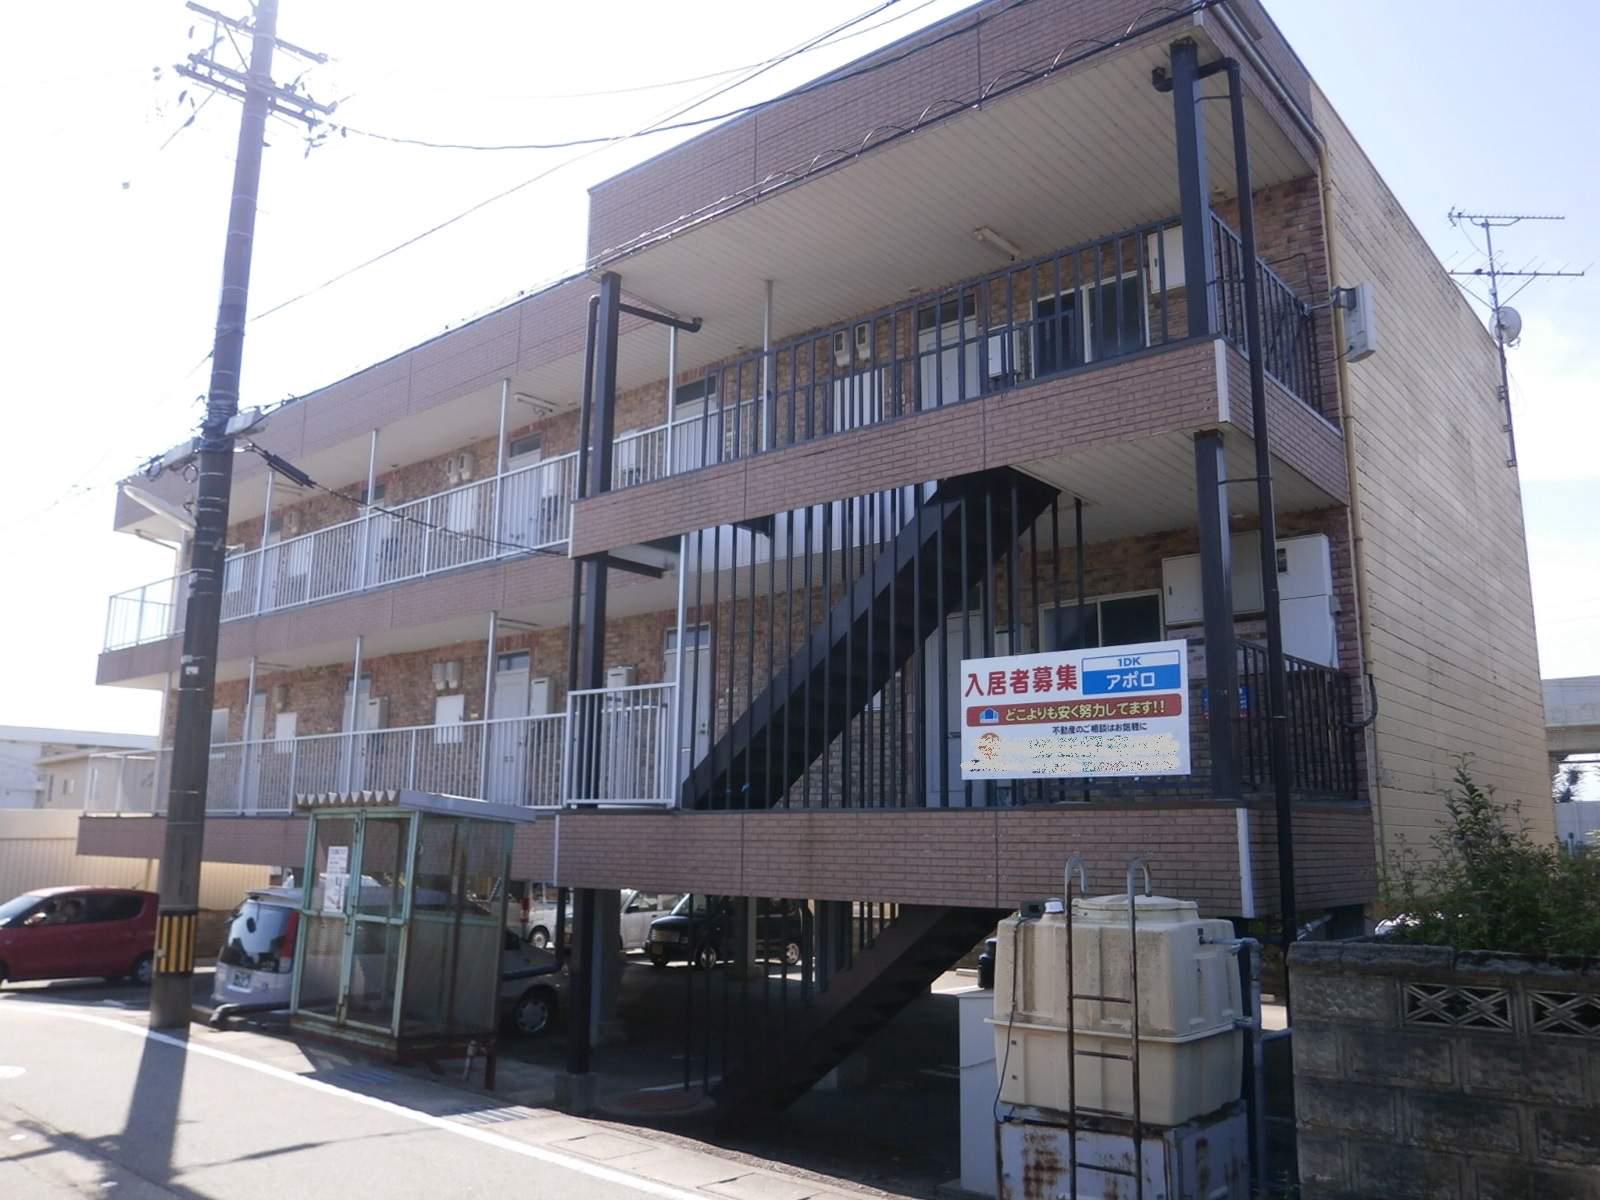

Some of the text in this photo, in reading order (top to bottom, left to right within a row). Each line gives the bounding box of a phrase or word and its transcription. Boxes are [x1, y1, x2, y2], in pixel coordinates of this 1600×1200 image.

[1117, 657, 1141, 667] 1DK
[965, 664, 1077, 697] 入居者募集
[1106, 671, 1155, 690] アポロ
